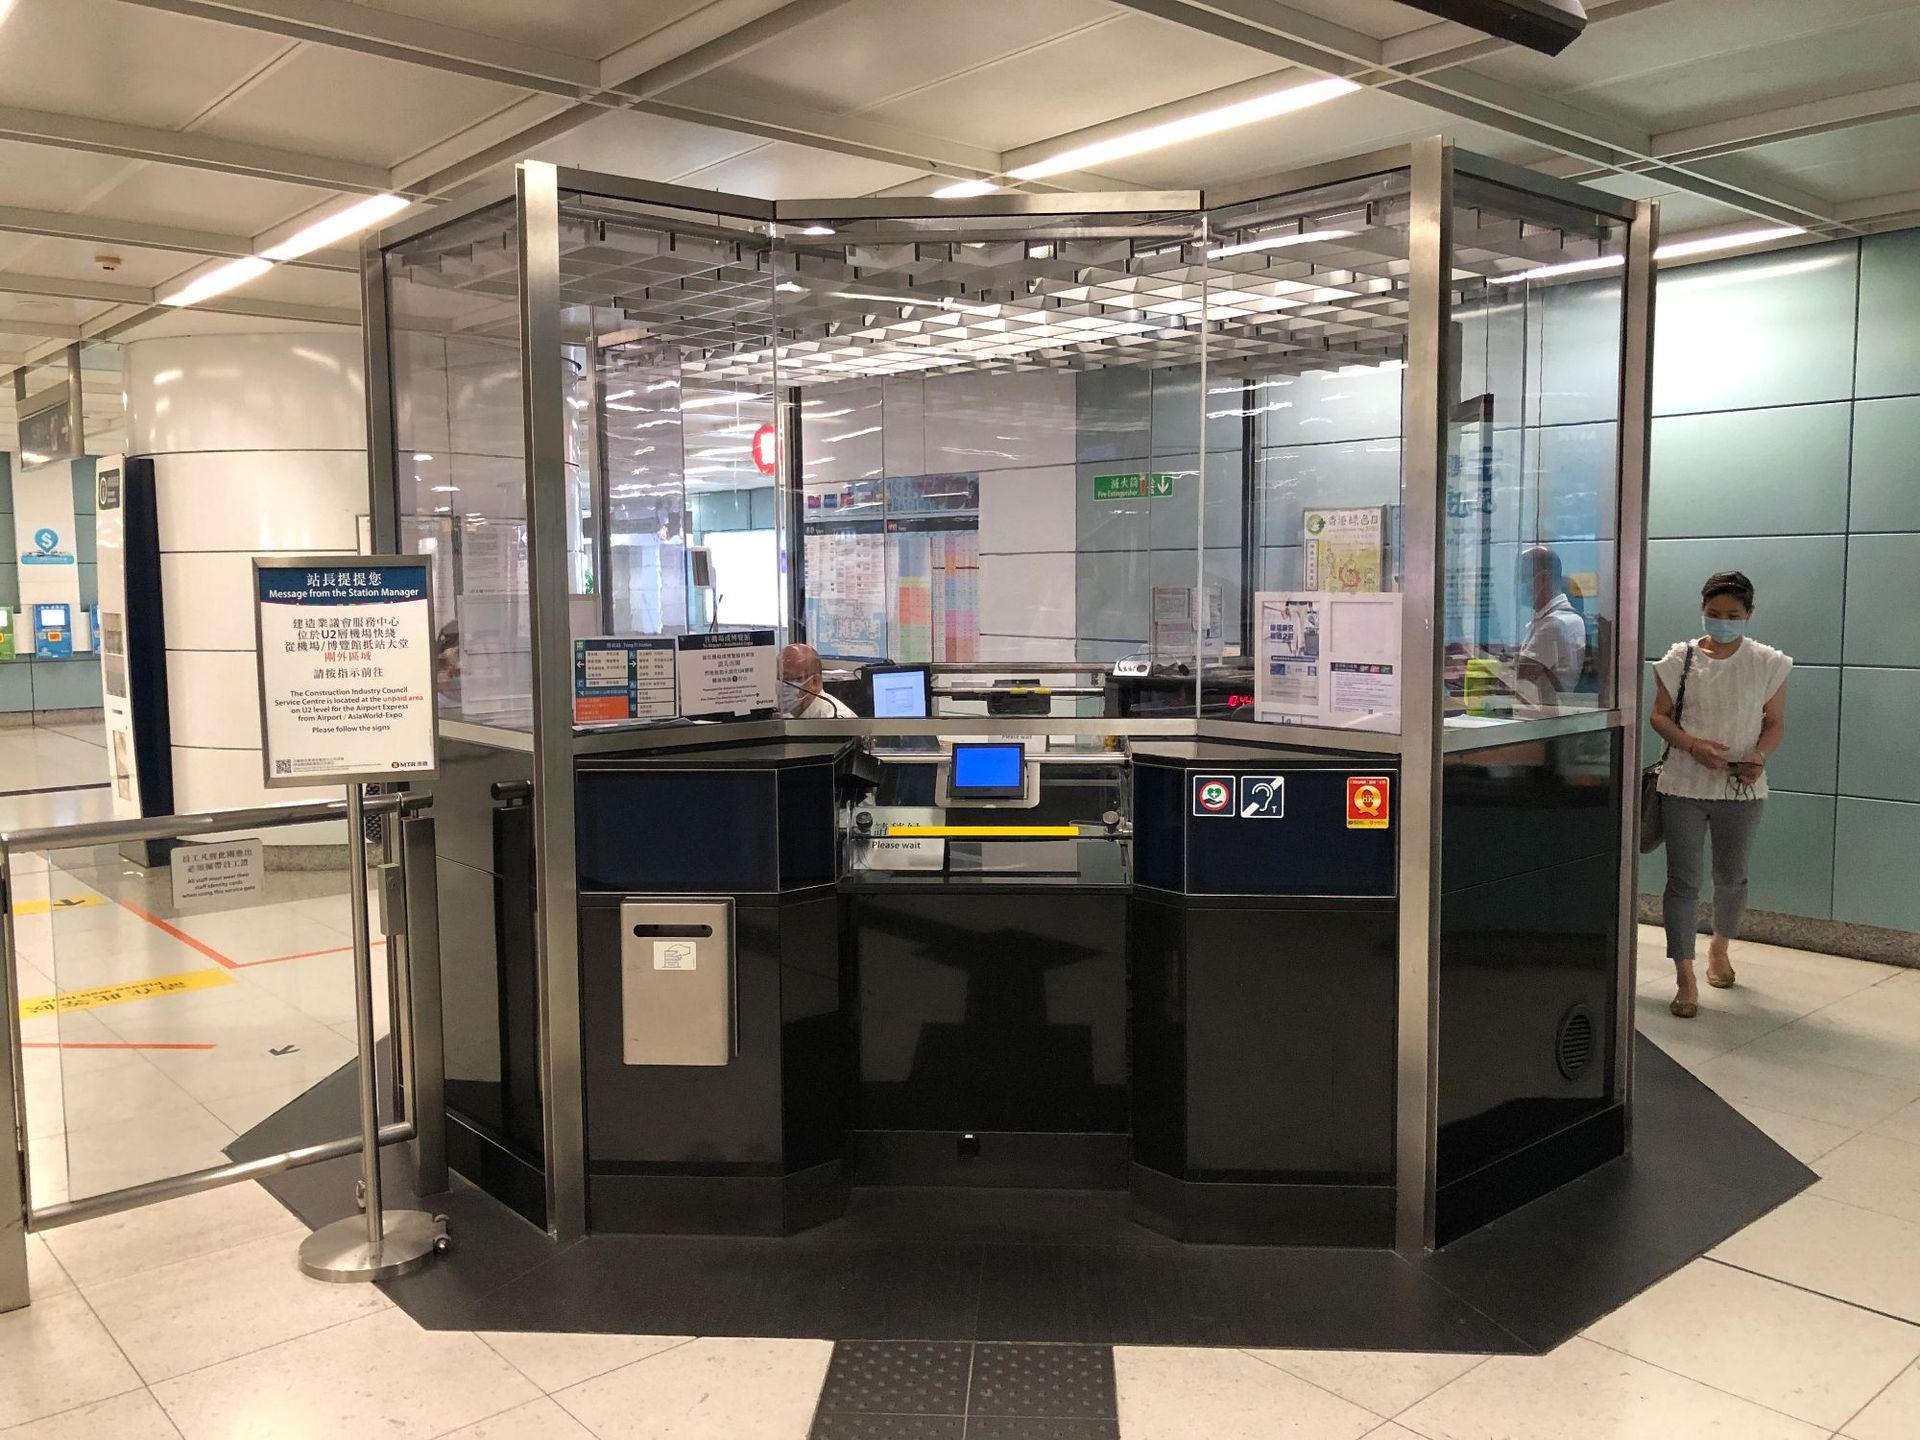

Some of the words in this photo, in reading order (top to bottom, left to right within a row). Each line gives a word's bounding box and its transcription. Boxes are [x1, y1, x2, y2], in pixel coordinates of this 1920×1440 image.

[1111, 477, 1138, 489] 滅火筒
[1098, 490, 1107, 498] Fire
[1108, 490, 1138, 498] Extinguisher
[306, 572, 382, 587] 站長提提您
[269, 589, 308, 600] Message
[309, 589, 331, 598] from
[332, 588, 346, 597] the
[348, 588, 379, 597] Station
[381, 588, 419, 599] Manager
[293, 616, 400, 629] 建造業議會服務中心
[285, 639, 409, 653] 從機場/博覽館抵站大堂
[324, 651, 372, 663] 閘外區域
[313, 666, 384, 680] 請按指示前往
[304, 688, 350, 697] Construction
[351, 687, 381, 696] Industry
[382, 686, 408, 695] Council
[274, 699, 301, 707] Service
[302, 698, 325, 706] Centre
[334, 696, 360, 704] located
[382, 695, 407, 703] unpaid
[356, 704, 381, 712] Airport
[382, 703, 409, 711] Express
[298, 714, 315, 722] from
[317, 713, 342, 722] Airport
[348, 712, 403, 720] AsiaWorld-Expo
[312, 726, 335, 734] Please
[336, 725, 357, 733] follow
[358, 724, 371, 732] the
[372, 724, 390, 732] signs
[1272, 806, 1277, 814] T
[872, 841, 900, 849] Please
[901, 840, 921, 849] wait
